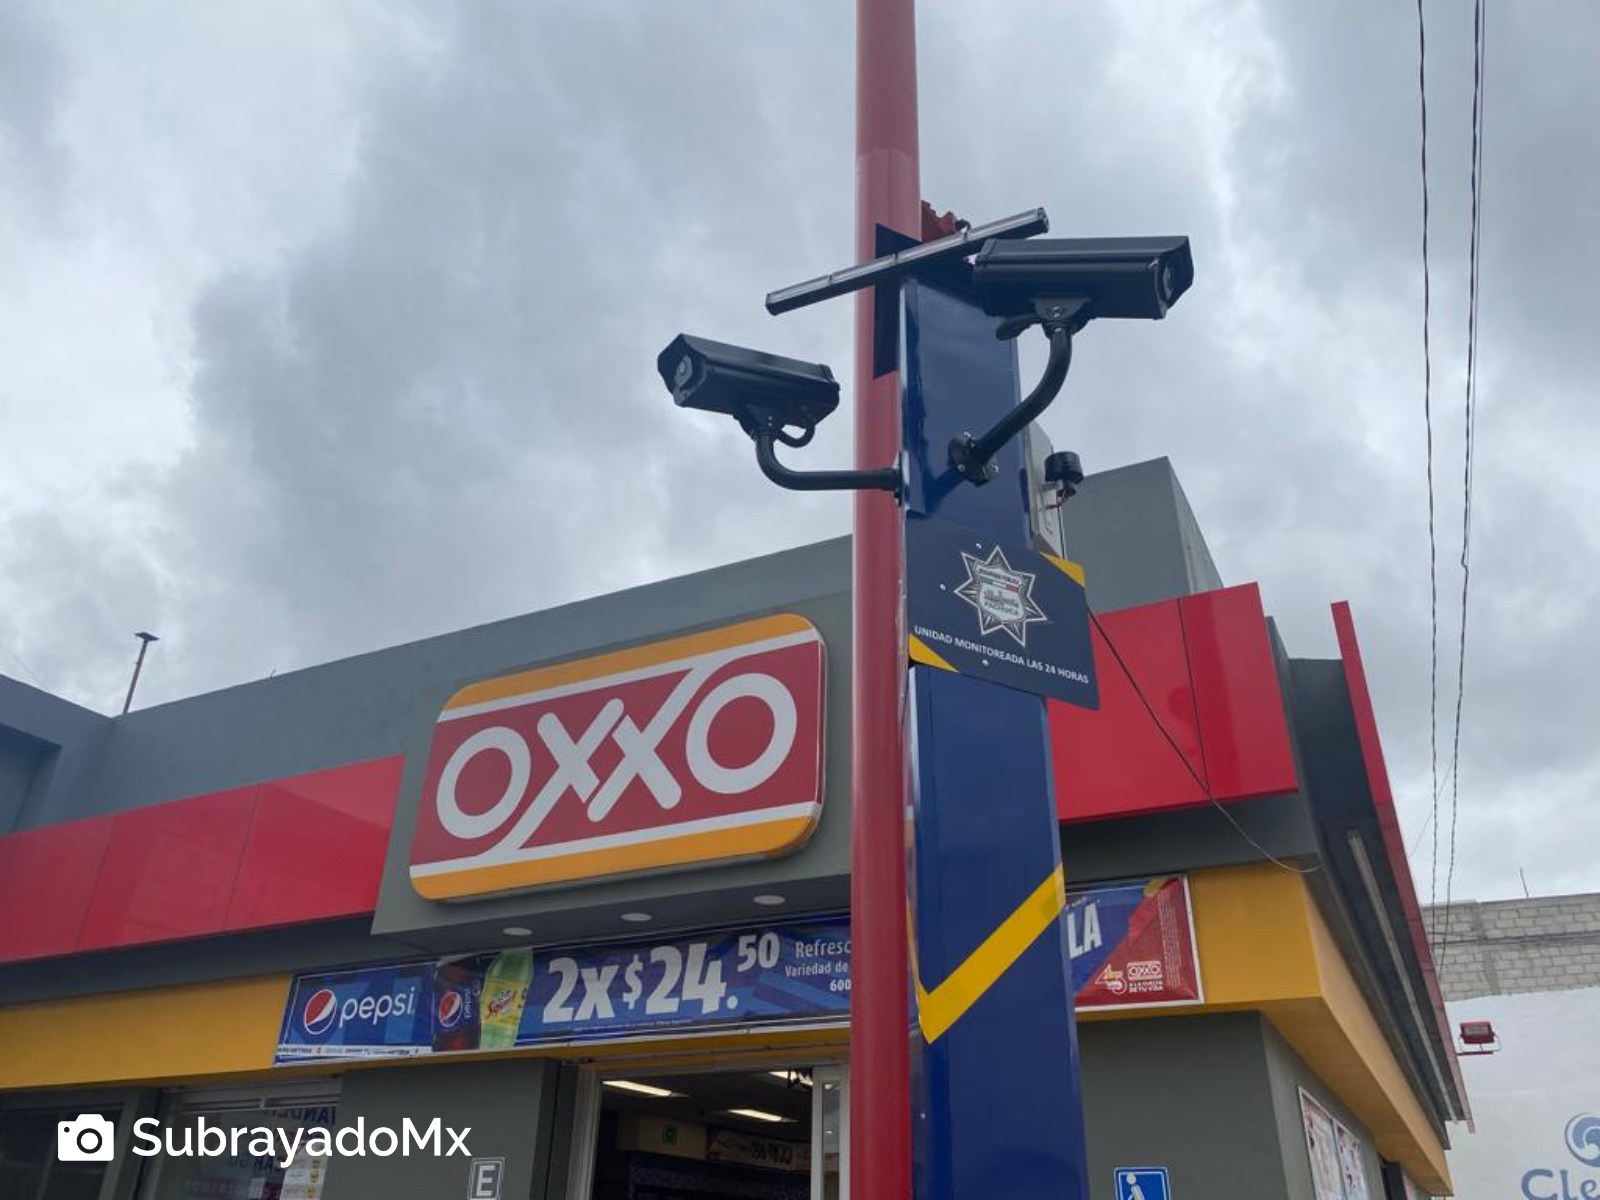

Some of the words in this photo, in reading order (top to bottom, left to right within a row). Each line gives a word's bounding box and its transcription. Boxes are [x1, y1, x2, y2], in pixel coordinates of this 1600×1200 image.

[914, 625, 953, 645] UNIDAD
[954, 637, 1025, 666] MONITOREADA
[1027, 657, 1043, 672] LAS
[1044, 663, 1056, 675] 24
[1057, 668, 1089, 684] HORAS
[436, 660, 798, 853] OXXO
[1067, 902, 1102, 959] LA
[785, 961, 831, 978] Variedad
[835, 960, 849, 973] de
[830, 979, 852, 992] 600
[339, 987, 416, 1028] pepsi
[476, 1165, 496, 1196] E
